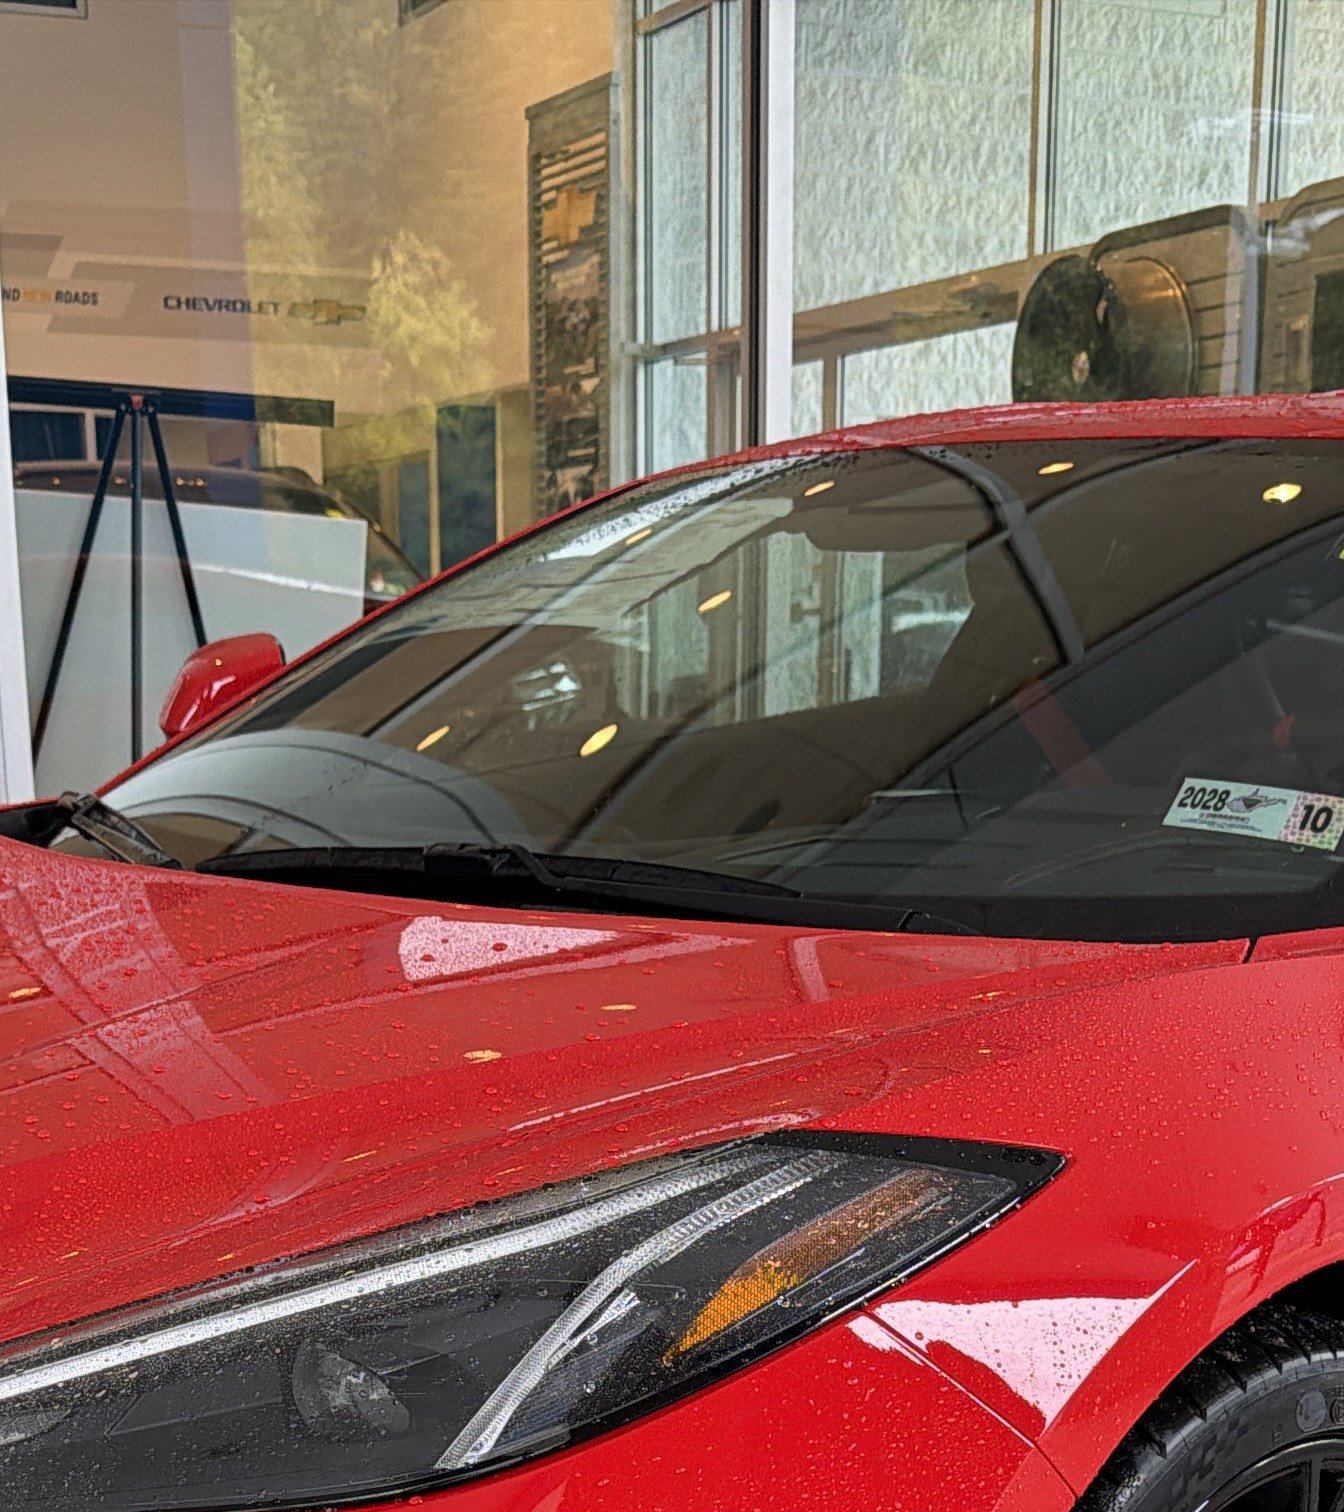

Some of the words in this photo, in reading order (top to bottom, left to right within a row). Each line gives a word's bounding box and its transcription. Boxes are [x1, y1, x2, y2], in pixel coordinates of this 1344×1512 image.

[55, 289, 99, 306] ROADS
[163, 296, 280, 315] CHEVROLET
[1177, 786, 1231, 812] 2028
[1298, 804, 1334, 834] 10
